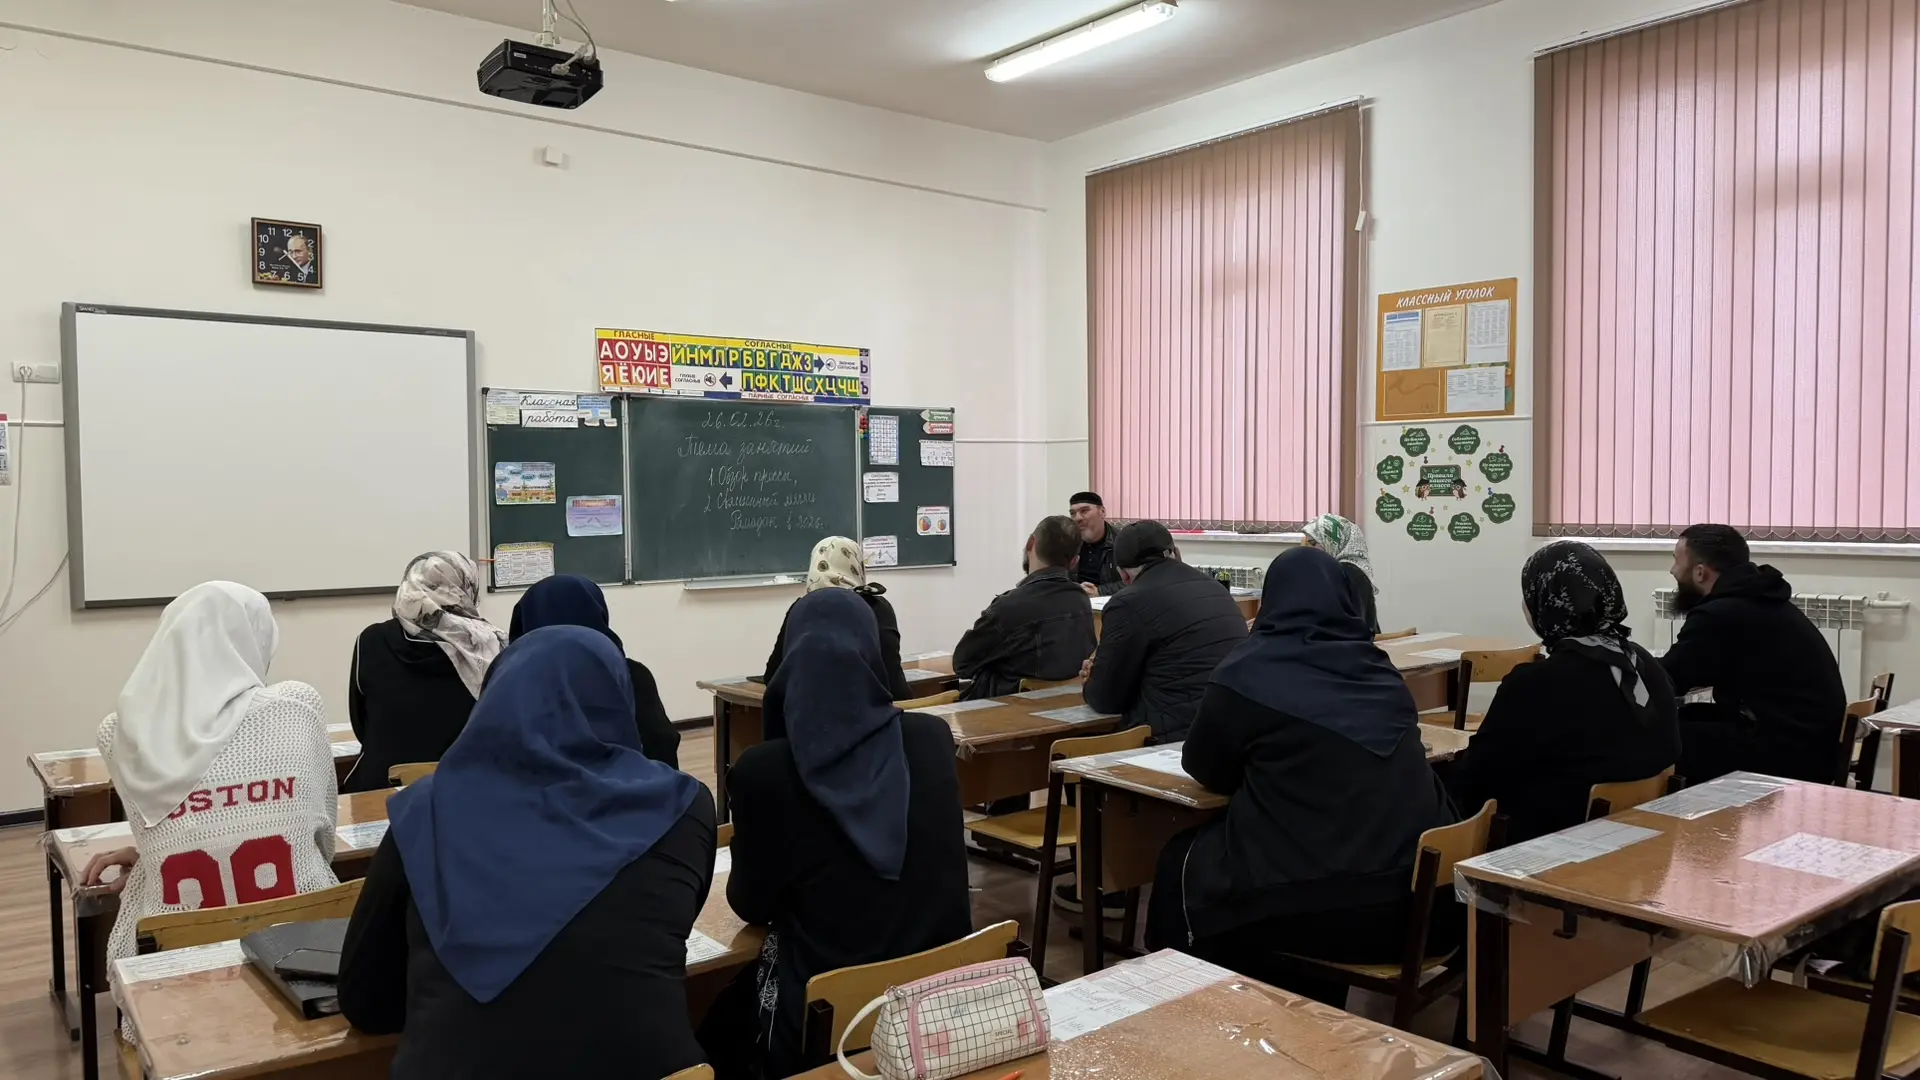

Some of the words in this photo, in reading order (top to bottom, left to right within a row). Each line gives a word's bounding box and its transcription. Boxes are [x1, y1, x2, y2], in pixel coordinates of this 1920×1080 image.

[268, 227, 276, 236] 11
[282, 228, 293, 238] 12
[259, 234, 269, 244] 10
[308, 239, 314, 248] 2
[258, 247, 266, 257] 9
[308, 252, 314, 261] 3
[259, 261, 266, 270] 8
[308, 265, 314, 274] 4
[270, 270, 277, 279] 7
[284, 271, 291, 281] 6
[297, 272, 304, 282] 5
[1396, 288, 1452, 308] КЛАССНЫЙ
[1455, 286, 1496, 301] УГОЛОК
[613, 330, 655, 340] ГЛАСНЫЕ
[744, 340, 792, 350] СОГЛАСНЫЕ
[521, 395, 577, 406] Классная
[677, 432, 732, 458] Тема
[719, 465, 749, 492] Обзор
[731, 509, 779, 537] Рамадан
